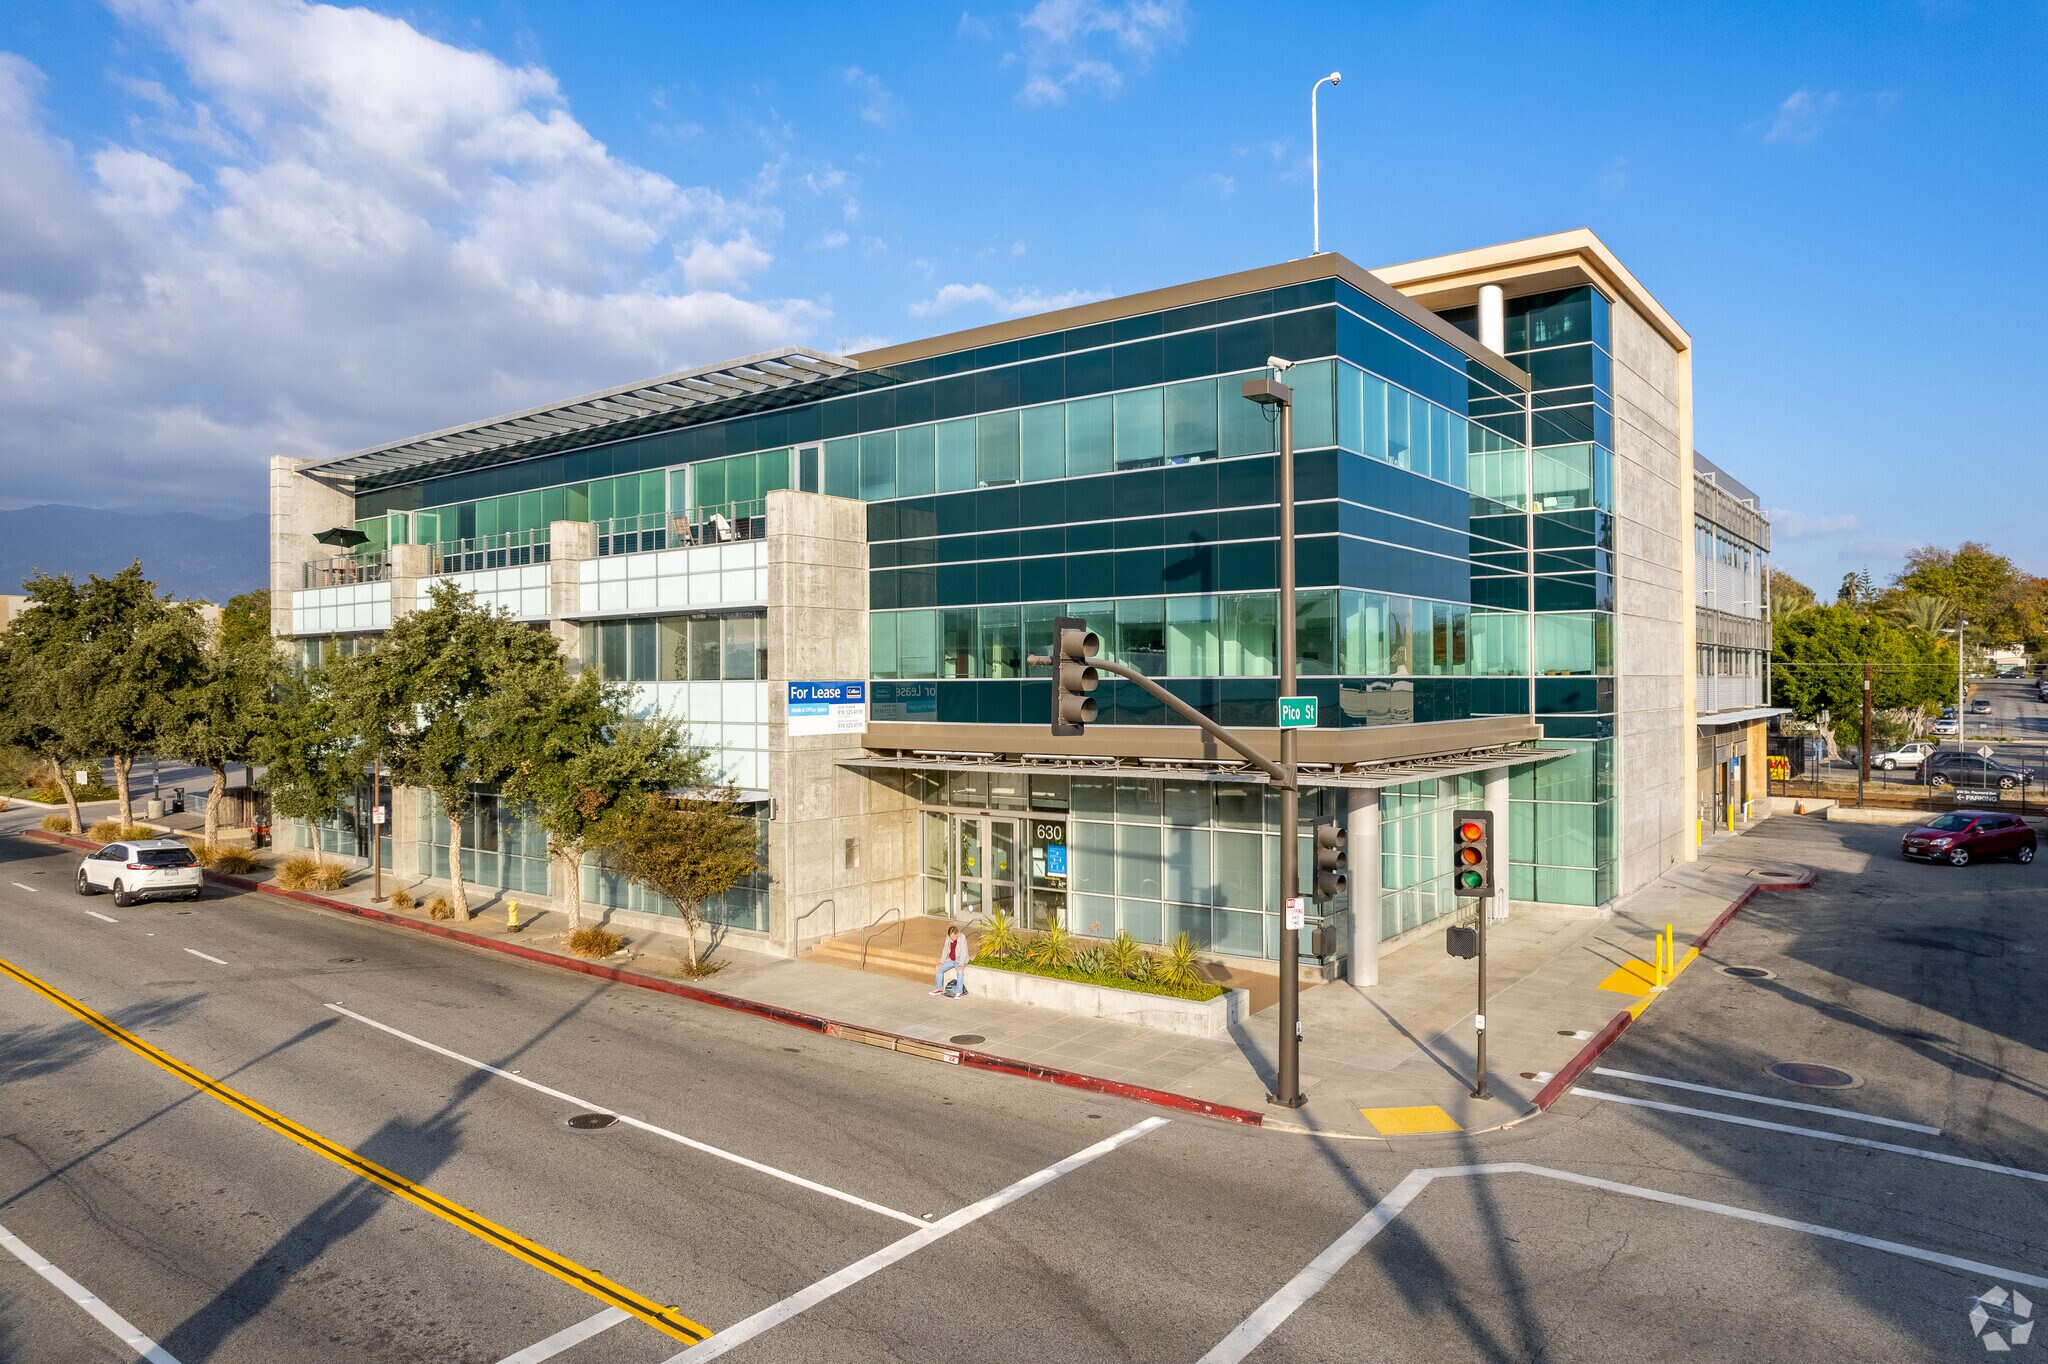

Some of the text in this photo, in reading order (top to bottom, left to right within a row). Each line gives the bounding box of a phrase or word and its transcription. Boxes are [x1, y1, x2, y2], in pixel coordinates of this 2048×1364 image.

[790, 686, 841, 699] For Lease
[1282, 704, 1314, 720] Pico St
[1965, 794, 1997, 802] PARKING
[1037, 824, 1062, 840] 630
